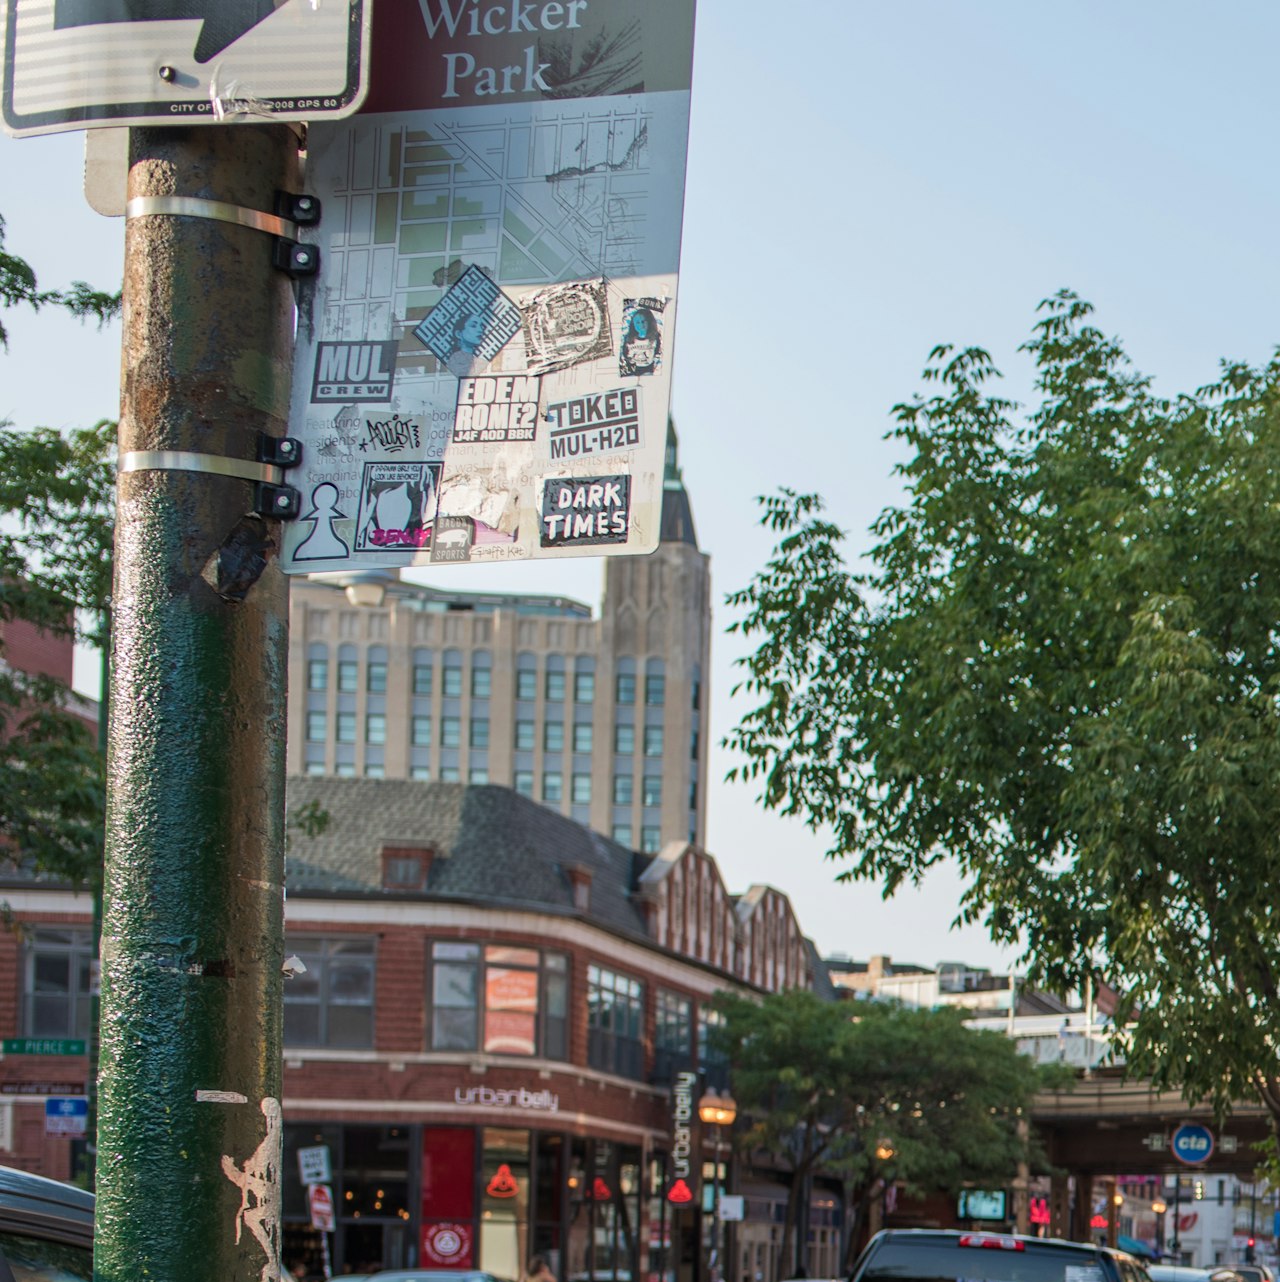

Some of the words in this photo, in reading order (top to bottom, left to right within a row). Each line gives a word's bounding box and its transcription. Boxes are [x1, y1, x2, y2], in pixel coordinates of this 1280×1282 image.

[418, 0, 588, 39] Wicker
[441, 45, 552, 98] Park
[170, 104, 196, 112] CITY
[197, 103, 211, 111] OF
[297, 100, 320, 108] GPS
[324, 99, 337, 107] 60
[318, 344, 391, 382] MUL
[319, 386, 386, 395] CREW
[459, 376, 539, 404] EDEM
[454, 402, 538, 431] ROME2
[454, 431, 478, 442] J4F
[480, 430, 505, 441] AOD
[508, 428, 535, 440] BBK
[558, 483, 622, 509] DARK
[544, 511, 627, 540] TIMES
[435, 549, 466, 560] SPORTS
[25, 1040, 65, 1054] PIERCE
[454, 1085, 559, 1113] urbanbelly
[673, 1072, 696, 1178] urbanbelly
[1178, 1134, 1208, 1151] cta
